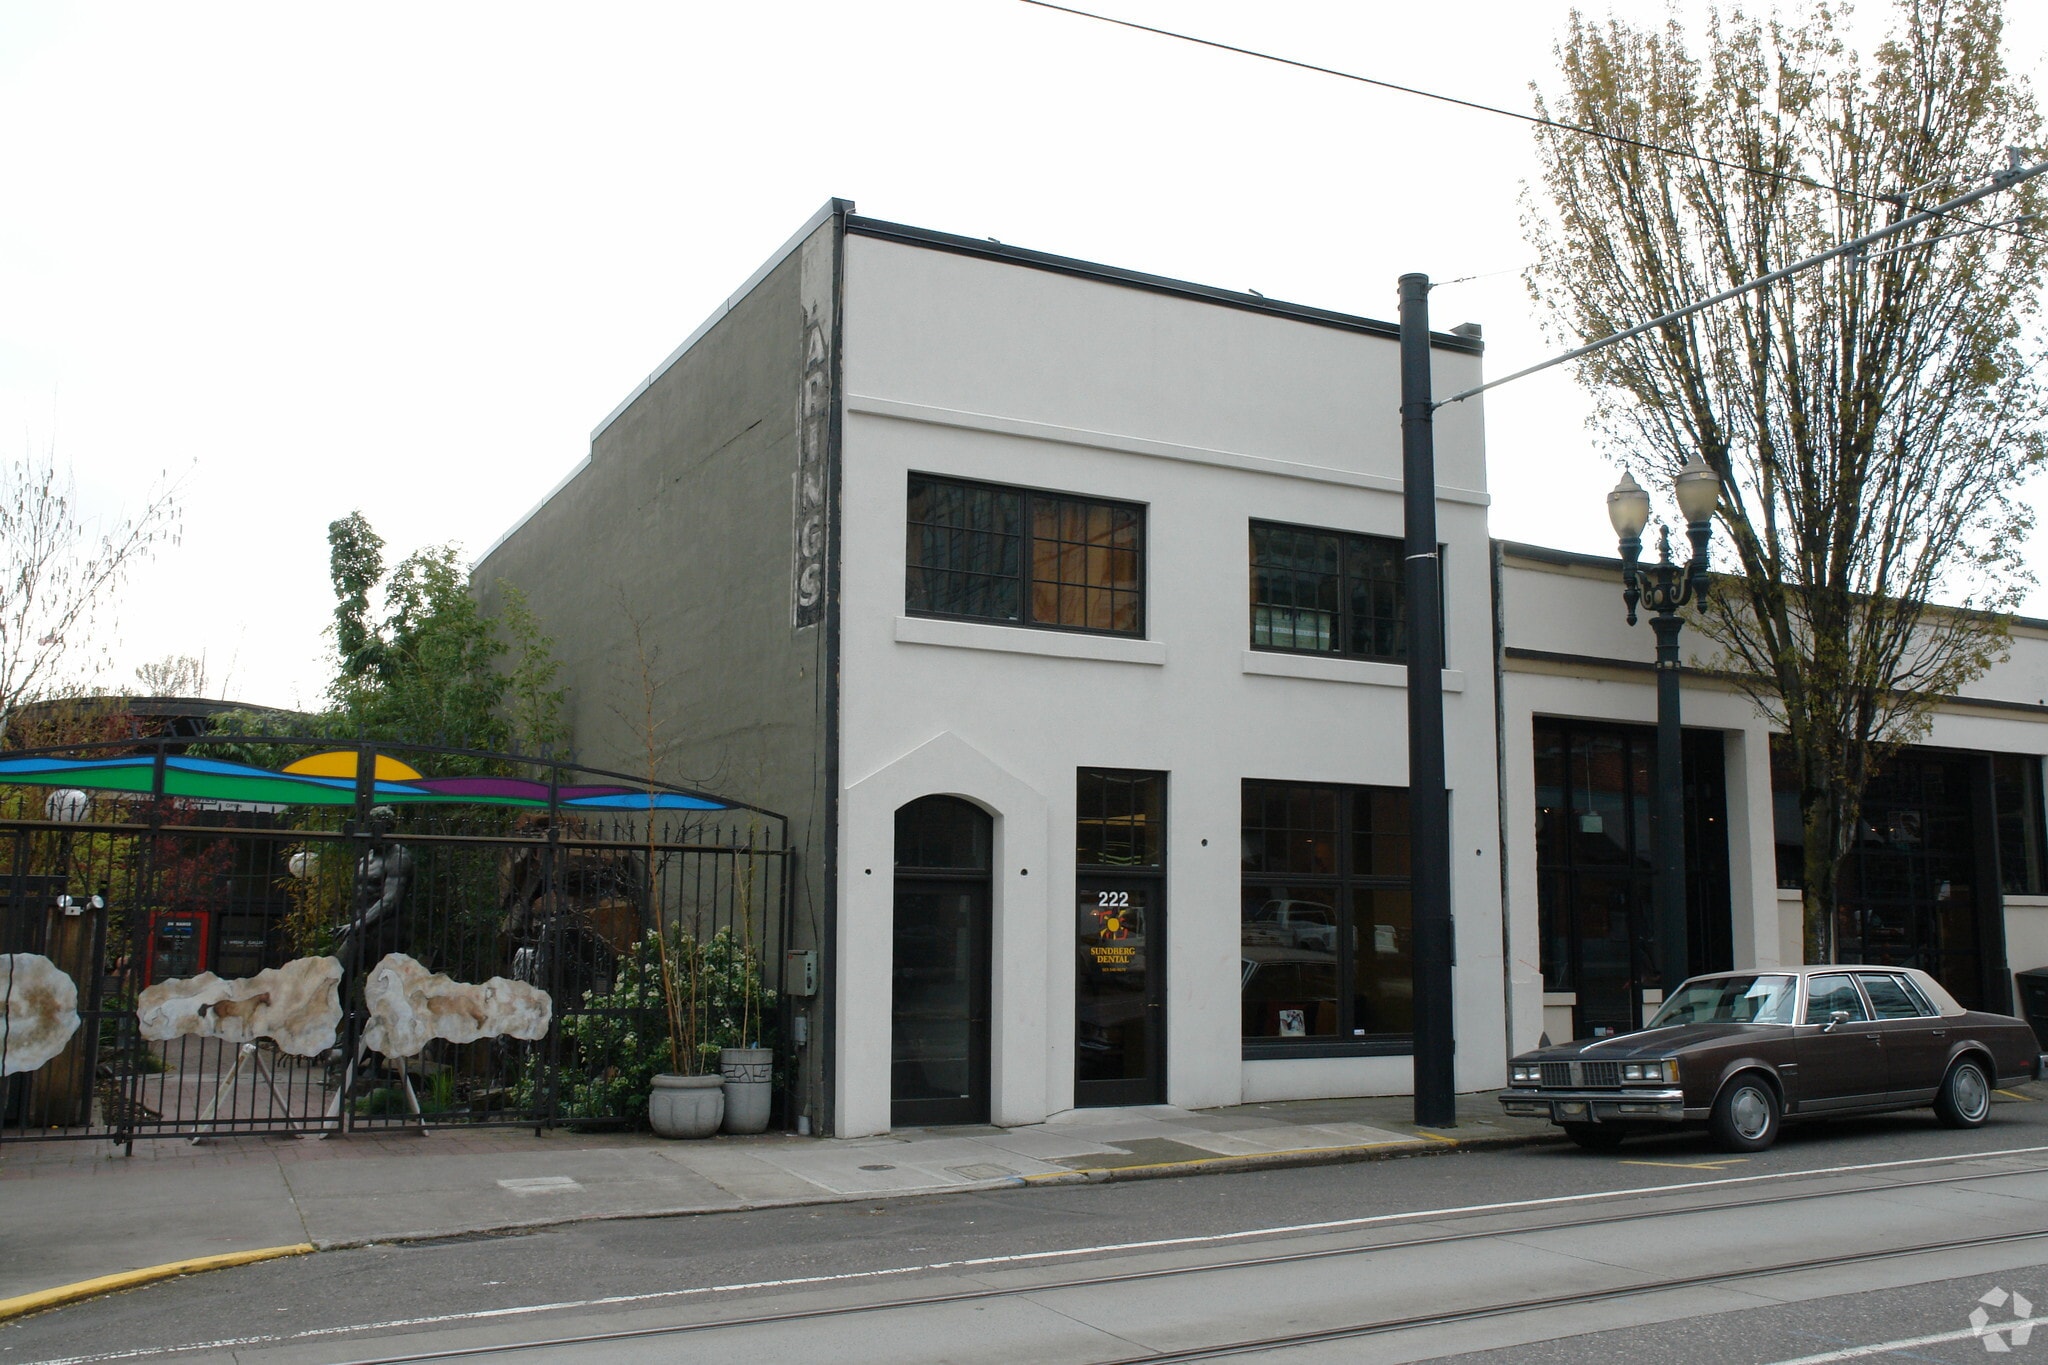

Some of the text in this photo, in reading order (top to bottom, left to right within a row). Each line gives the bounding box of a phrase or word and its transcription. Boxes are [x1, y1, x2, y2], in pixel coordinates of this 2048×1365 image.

[1098, 891, 1129, 907] 222
[1090, 947, 1136, 956] SUNDBERG
[1097, 955, 1130, 964] DENTAL
